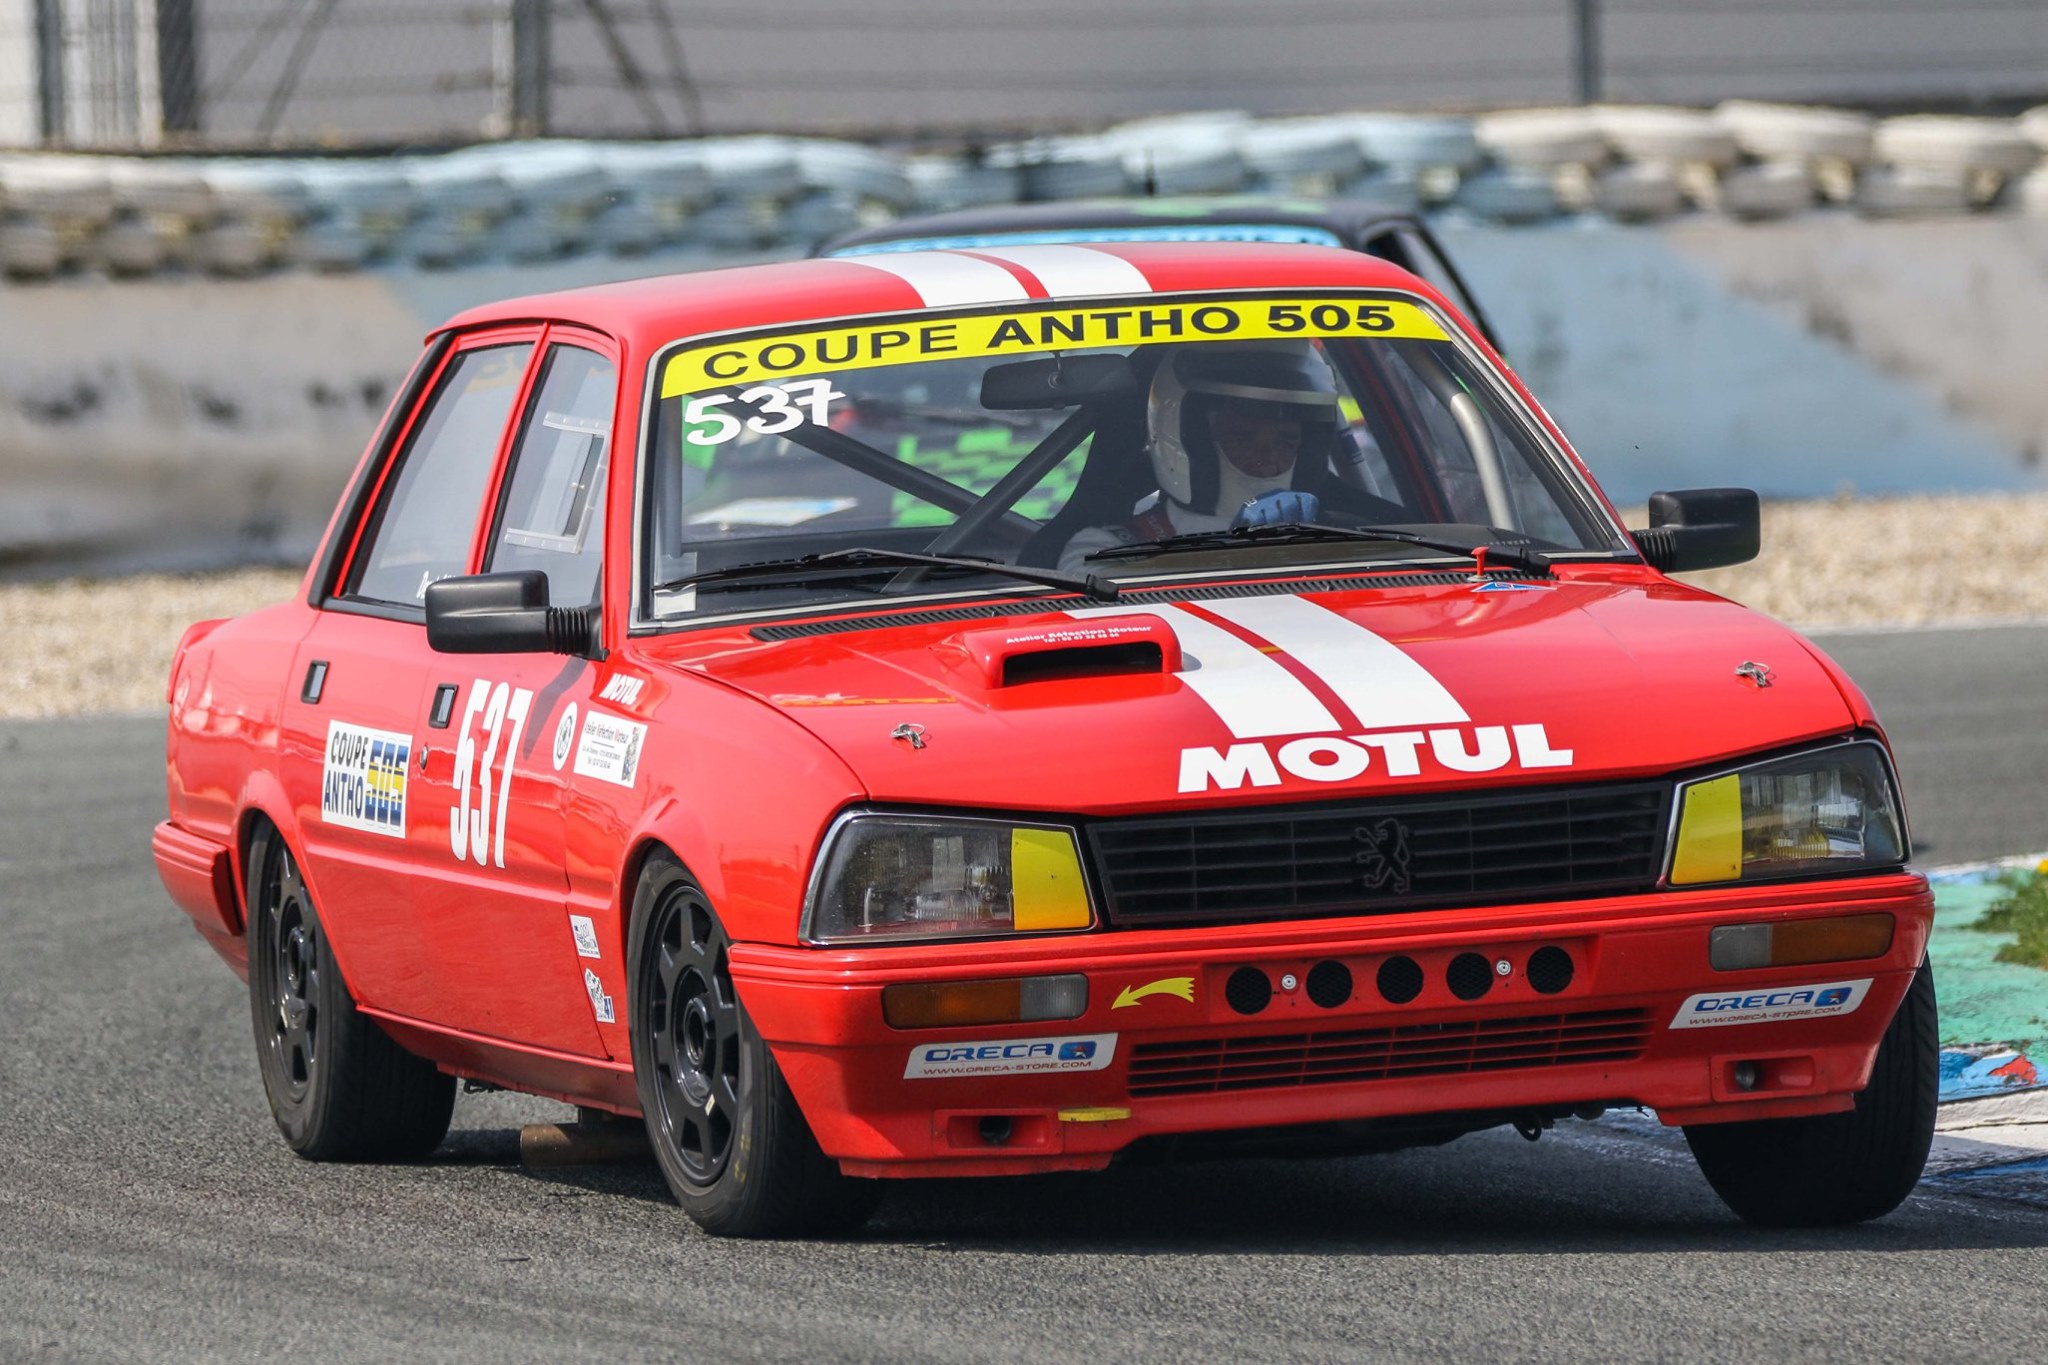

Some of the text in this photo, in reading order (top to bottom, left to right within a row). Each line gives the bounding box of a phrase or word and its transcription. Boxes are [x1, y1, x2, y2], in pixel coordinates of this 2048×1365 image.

[703, 305, 1396, 379] COUPE ANTHO 505
[684, 379, 846, 445] 537
[1006, 634, 1045, 644] Atelier
[1108, 626, 1152, 634] Moteur
[598, 673, 645, 705] MOTUL
[331, 730, 369, 770] COUPE
[1178, 722, 1574, 793] MOTUL
[450, 678, 534, 869] 537
[324, 770, 364, 819] ANTHO
[1689, 1006, 1842, 1025] WWW.ORECA-STORE.COM
[1695, 990, 1815, 1012] ORECA
[923, 1061, 1092, 1075] WWW.ORECA-STORE.COM
[924, 1043, 1055, 1062] ORECA
